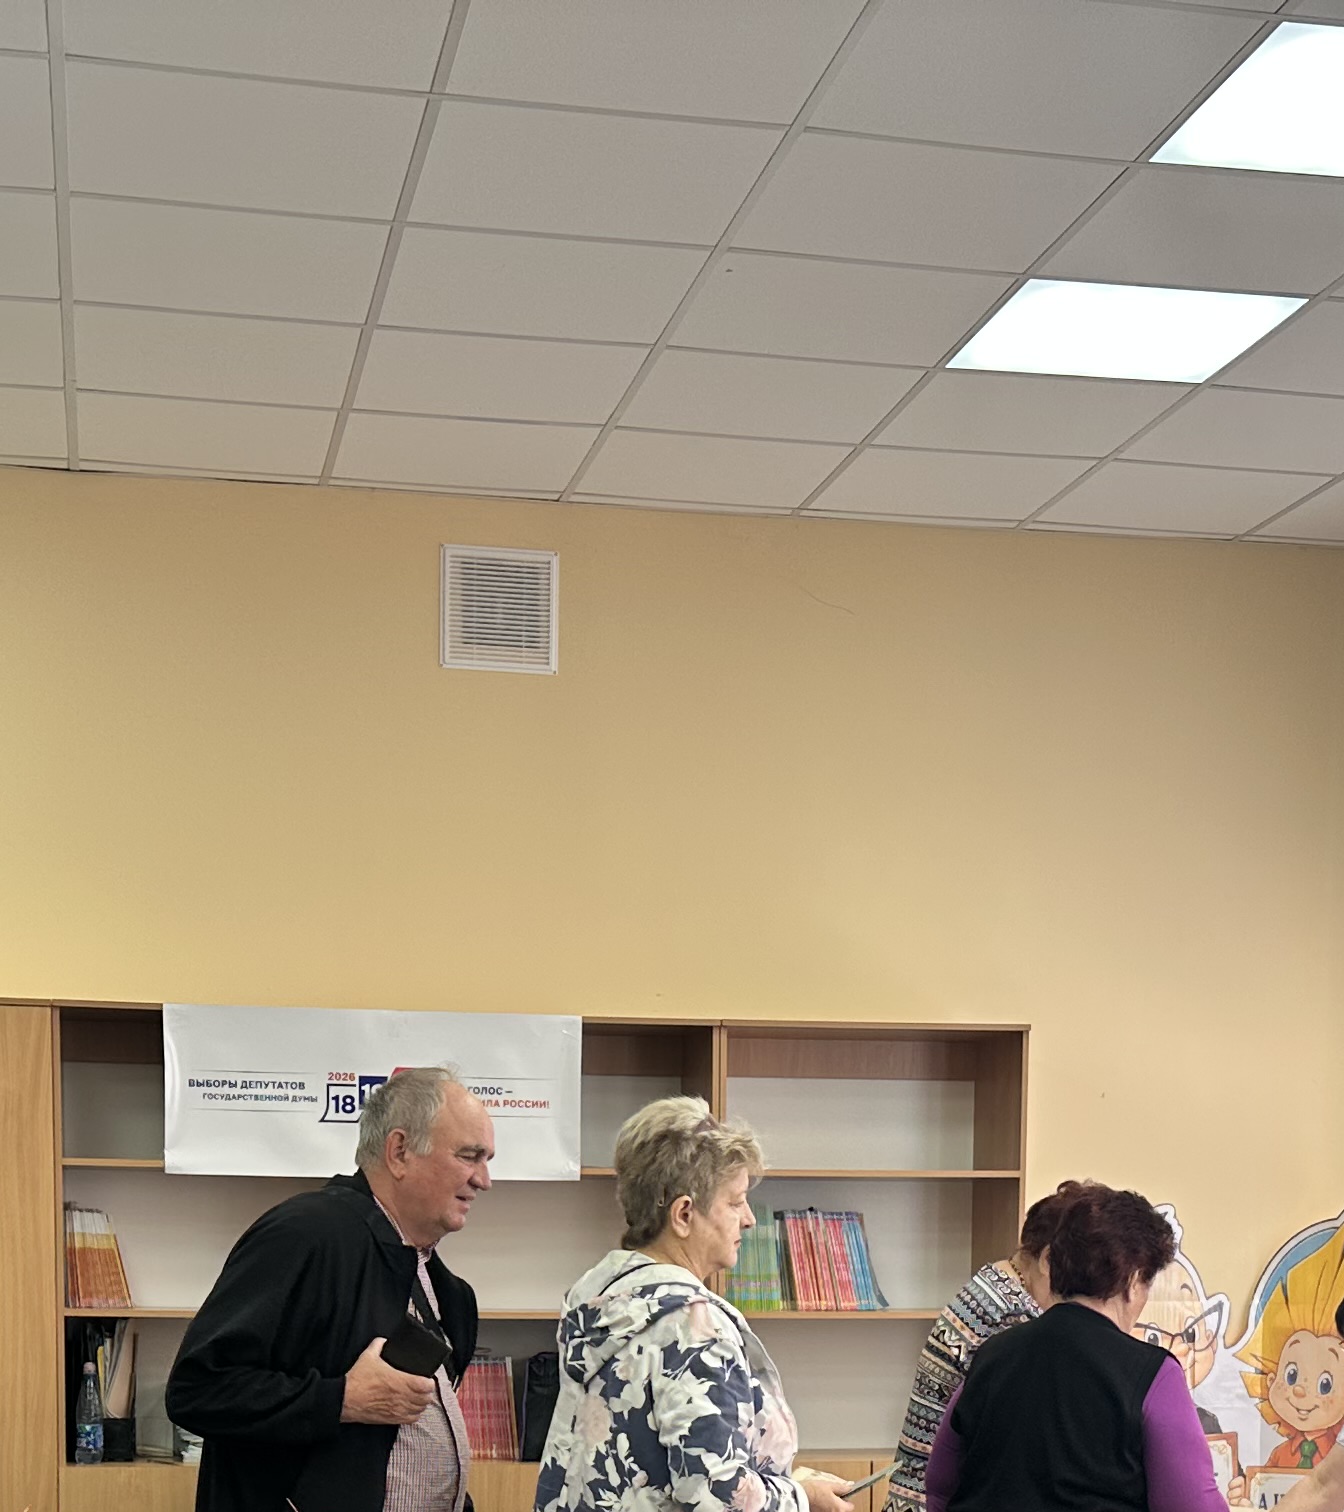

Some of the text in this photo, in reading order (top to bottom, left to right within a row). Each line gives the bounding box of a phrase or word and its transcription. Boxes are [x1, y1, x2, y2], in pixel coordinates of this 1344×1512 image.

[327, 1072, 355, 1081] 2026
[188, 1079, 306, 1091] ВЫБОРЫ ДЕПУТАТОВ
[202, 1093, 318, 1103] ГОСУДАРСТВЕННОЙ ДУМЫ
[331, 1094, 356, 1114] 18
[503, 1099, 550, 1109] РОССИИ!
